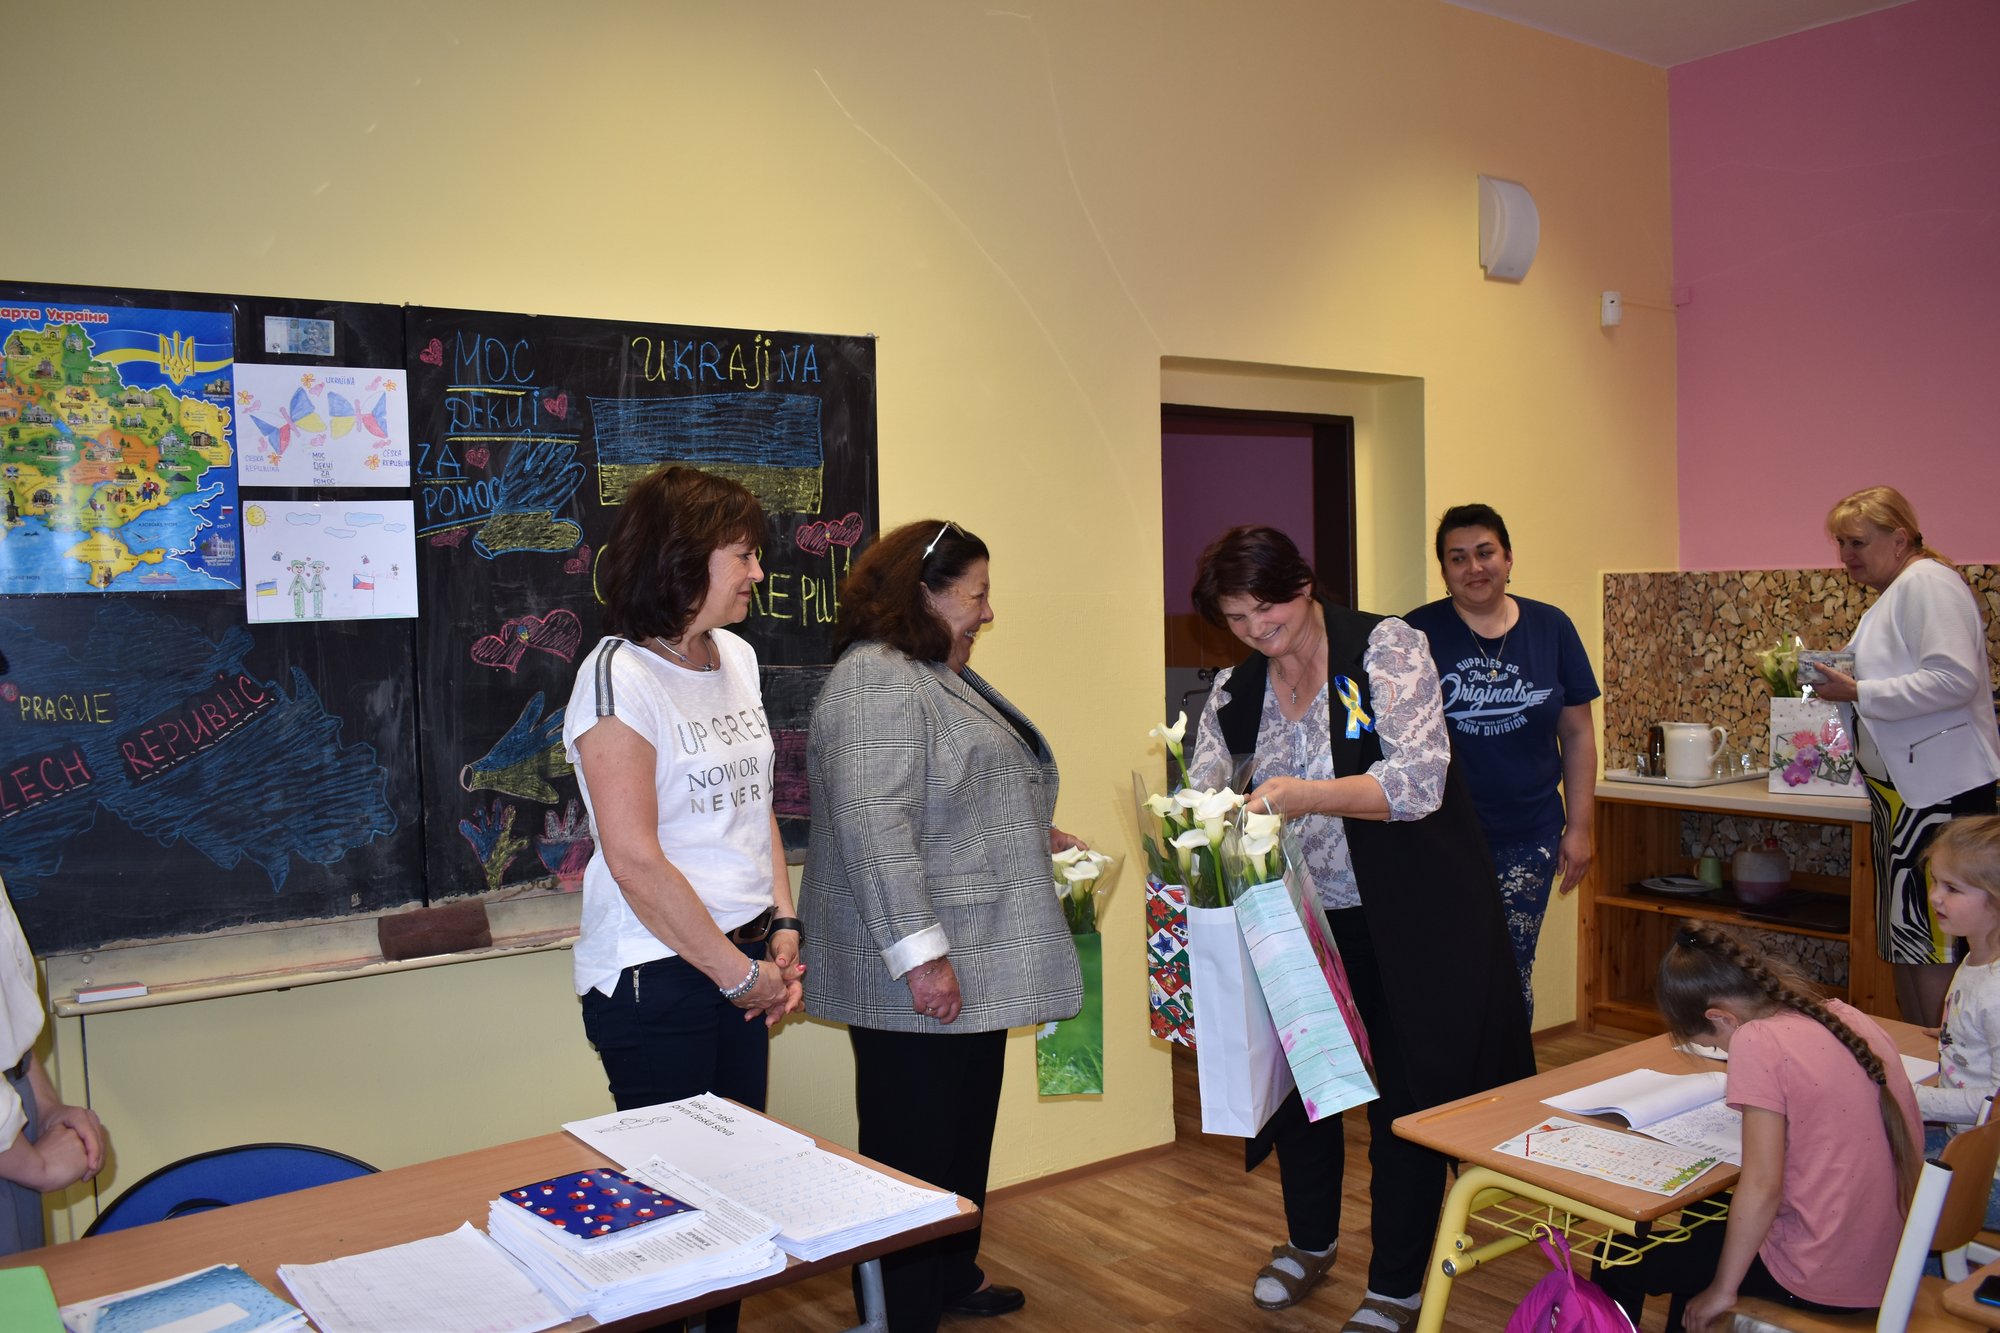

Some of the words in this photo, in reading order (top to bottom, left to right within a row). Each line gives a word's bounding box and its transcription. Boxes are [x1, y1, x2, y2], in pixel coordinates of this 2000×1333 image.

[46, 308, 109, 323] України
[454, 331, 535, 384] MOC
[417, 443, 461, 479] ZA
[422, 476, 505, 520] POMOC
[1456, 657, 1502, 672] SUPPLIES
[1505, 663, 1520, 676] CO.
[20, 693, 114, 723] PRAGUE
[677, 721, 708, 755] UP
[1484, 714, 1528, 736] DIVISION
[690, 784, 761, 814] NEVER
